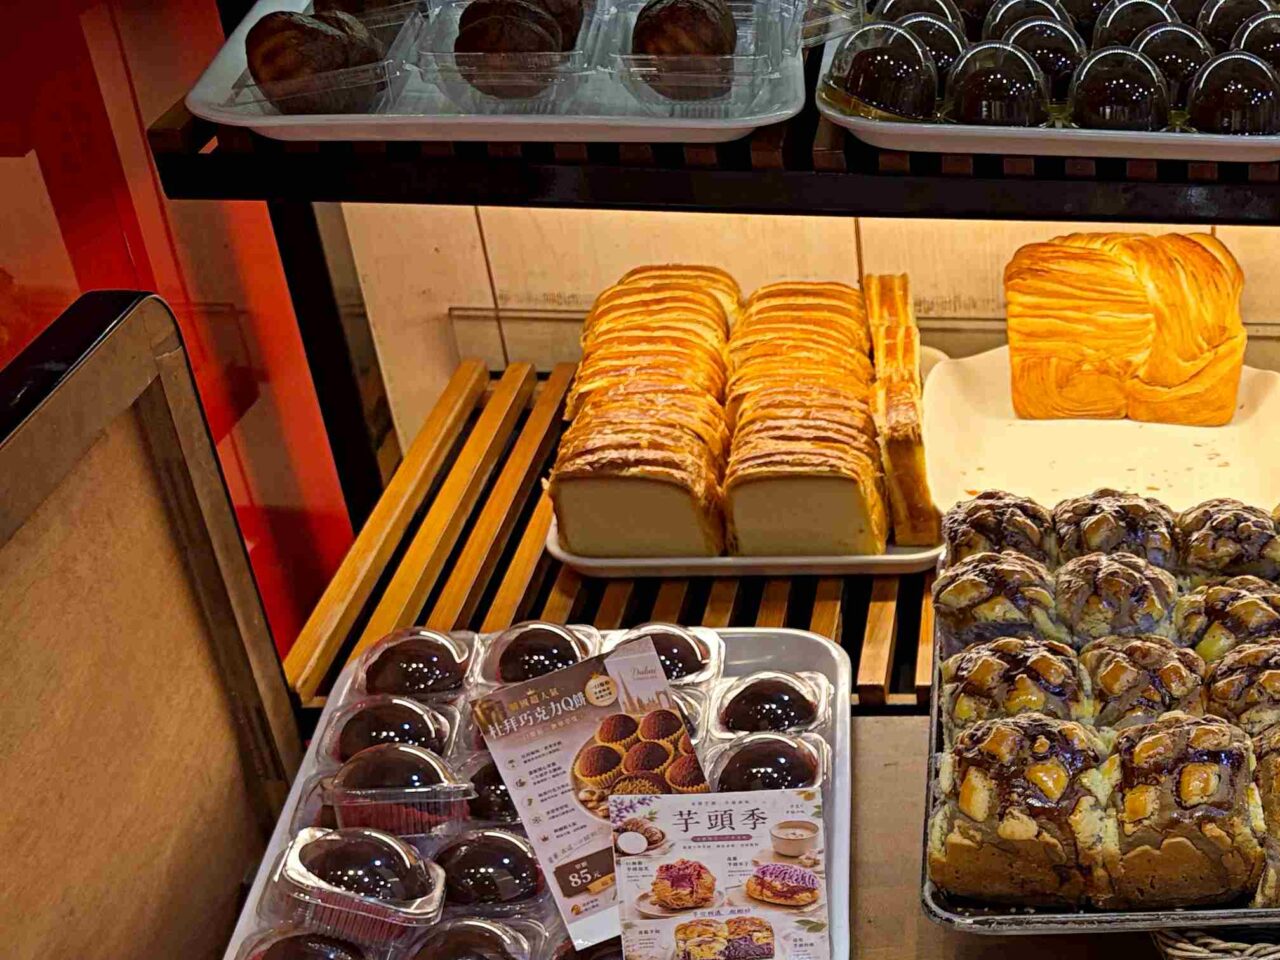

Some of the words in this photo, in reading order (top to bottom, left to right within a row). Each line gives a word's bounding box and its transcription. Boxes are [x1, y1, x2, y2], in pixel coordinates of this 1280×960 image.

[488, 691, 586, 739] 杜拜巧克力Q餅
[672, 807, 768, 832] 芋頭季
